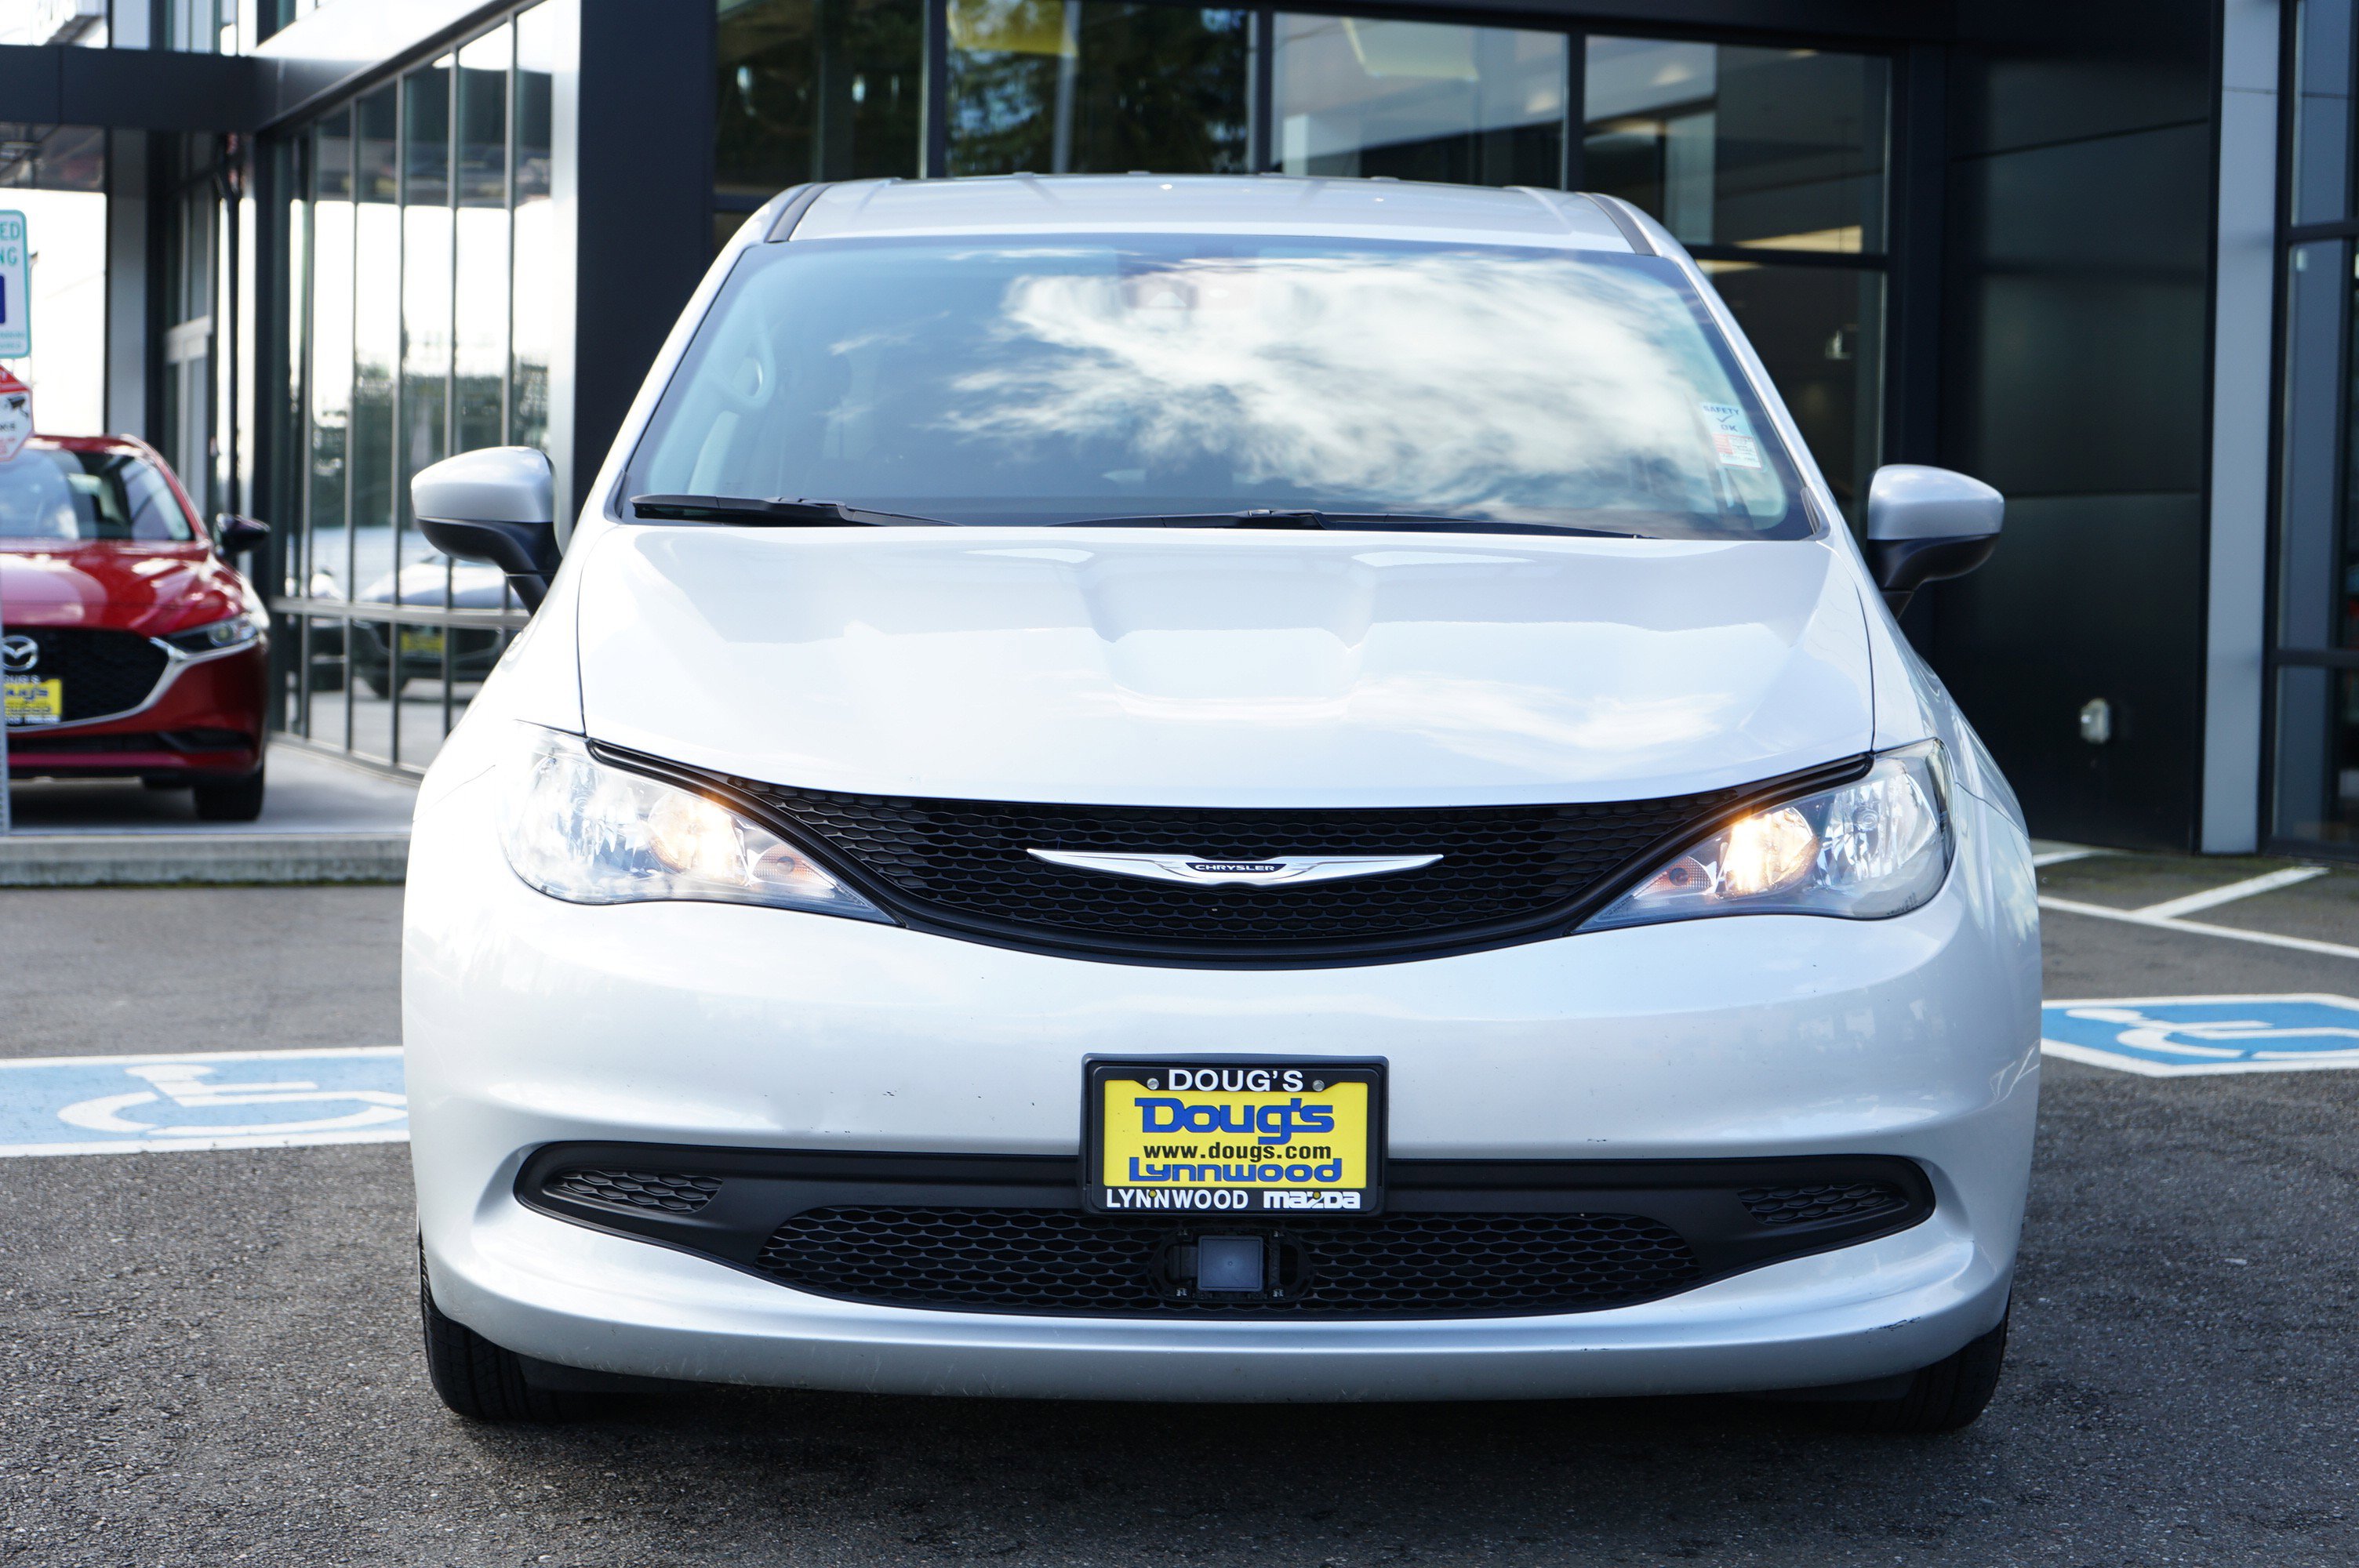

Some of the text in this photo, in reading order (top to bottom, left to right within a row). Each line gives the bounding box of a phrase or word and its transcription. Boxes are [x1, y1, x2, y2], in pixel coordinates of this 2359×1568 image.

[1703, 405, 1739, 416] SAFETY
[1168, 1069, 1303, 1092] DOUG'S
[1135, 1098, 1335, 1145] Doug's
[1143, 1142, 1331, 1163] www.dougs.com
[1129, 1157, 1342, 1182] Lynnwood
[1107, 1189, 1249, 1209] LYNNWOOD
